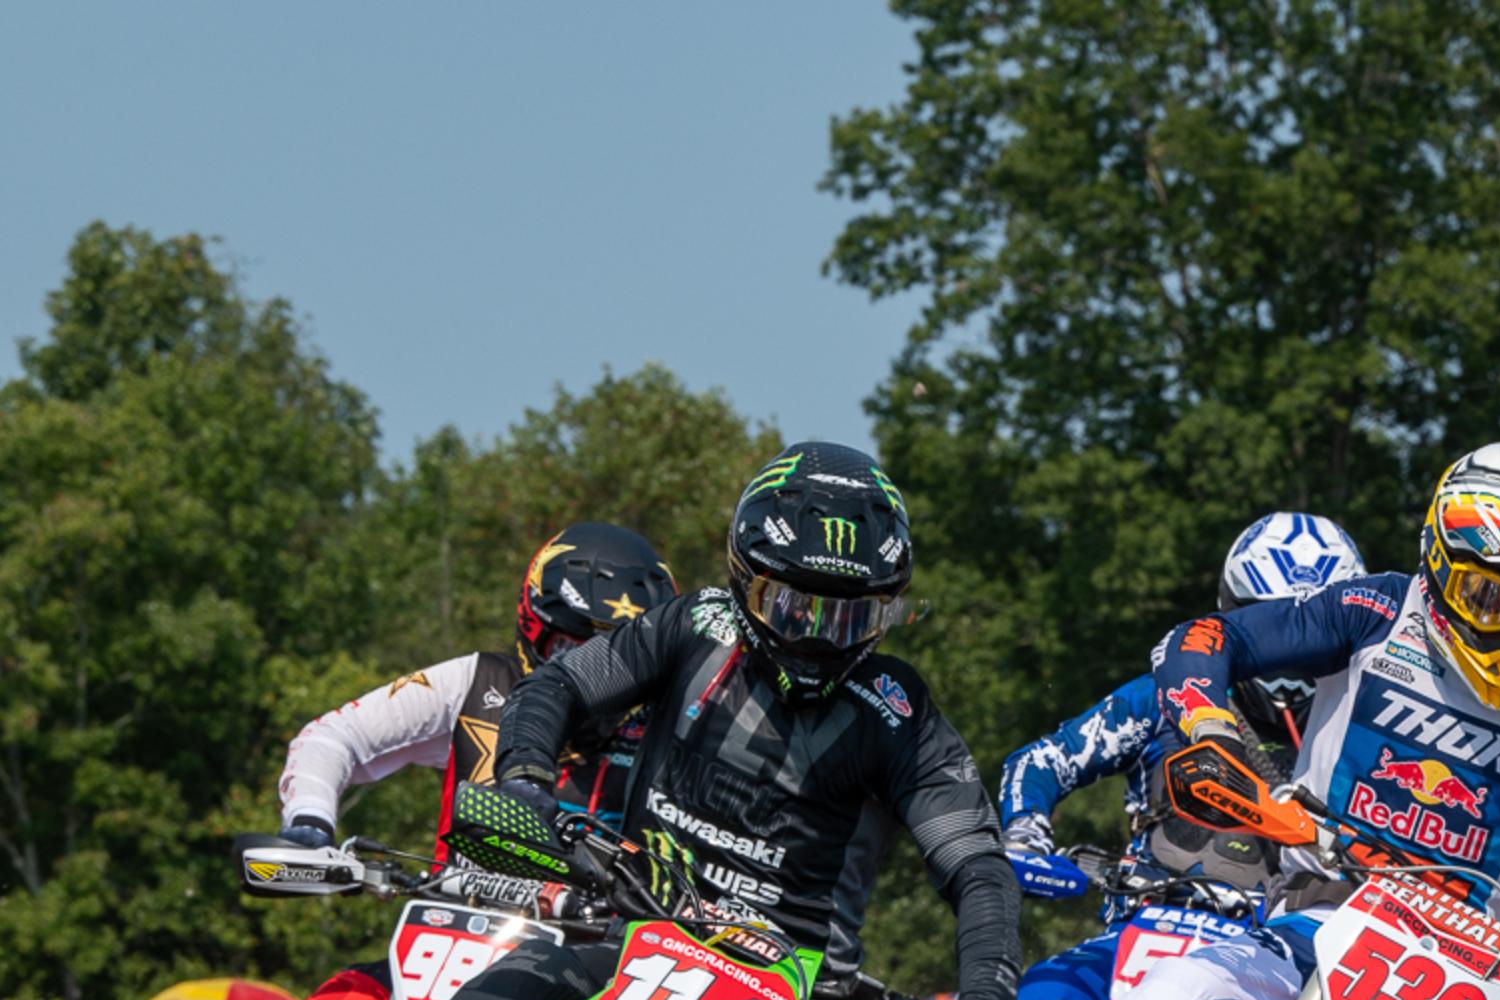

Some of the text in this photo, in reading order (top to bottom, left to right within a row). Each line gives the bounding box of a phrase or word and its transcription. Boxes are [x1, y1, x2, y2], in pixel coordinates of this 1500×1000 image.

[803, 555, 872, 575] MONSTER
[1195, 786, 1263, 825] ACERBIS
[1349, 782, 1489, 863] Red Bull
[646, 788, 787, 869] Kawasaki
[482, 833, 571, 876] ACERBIS
[702, 862, 784, 907] WPS
